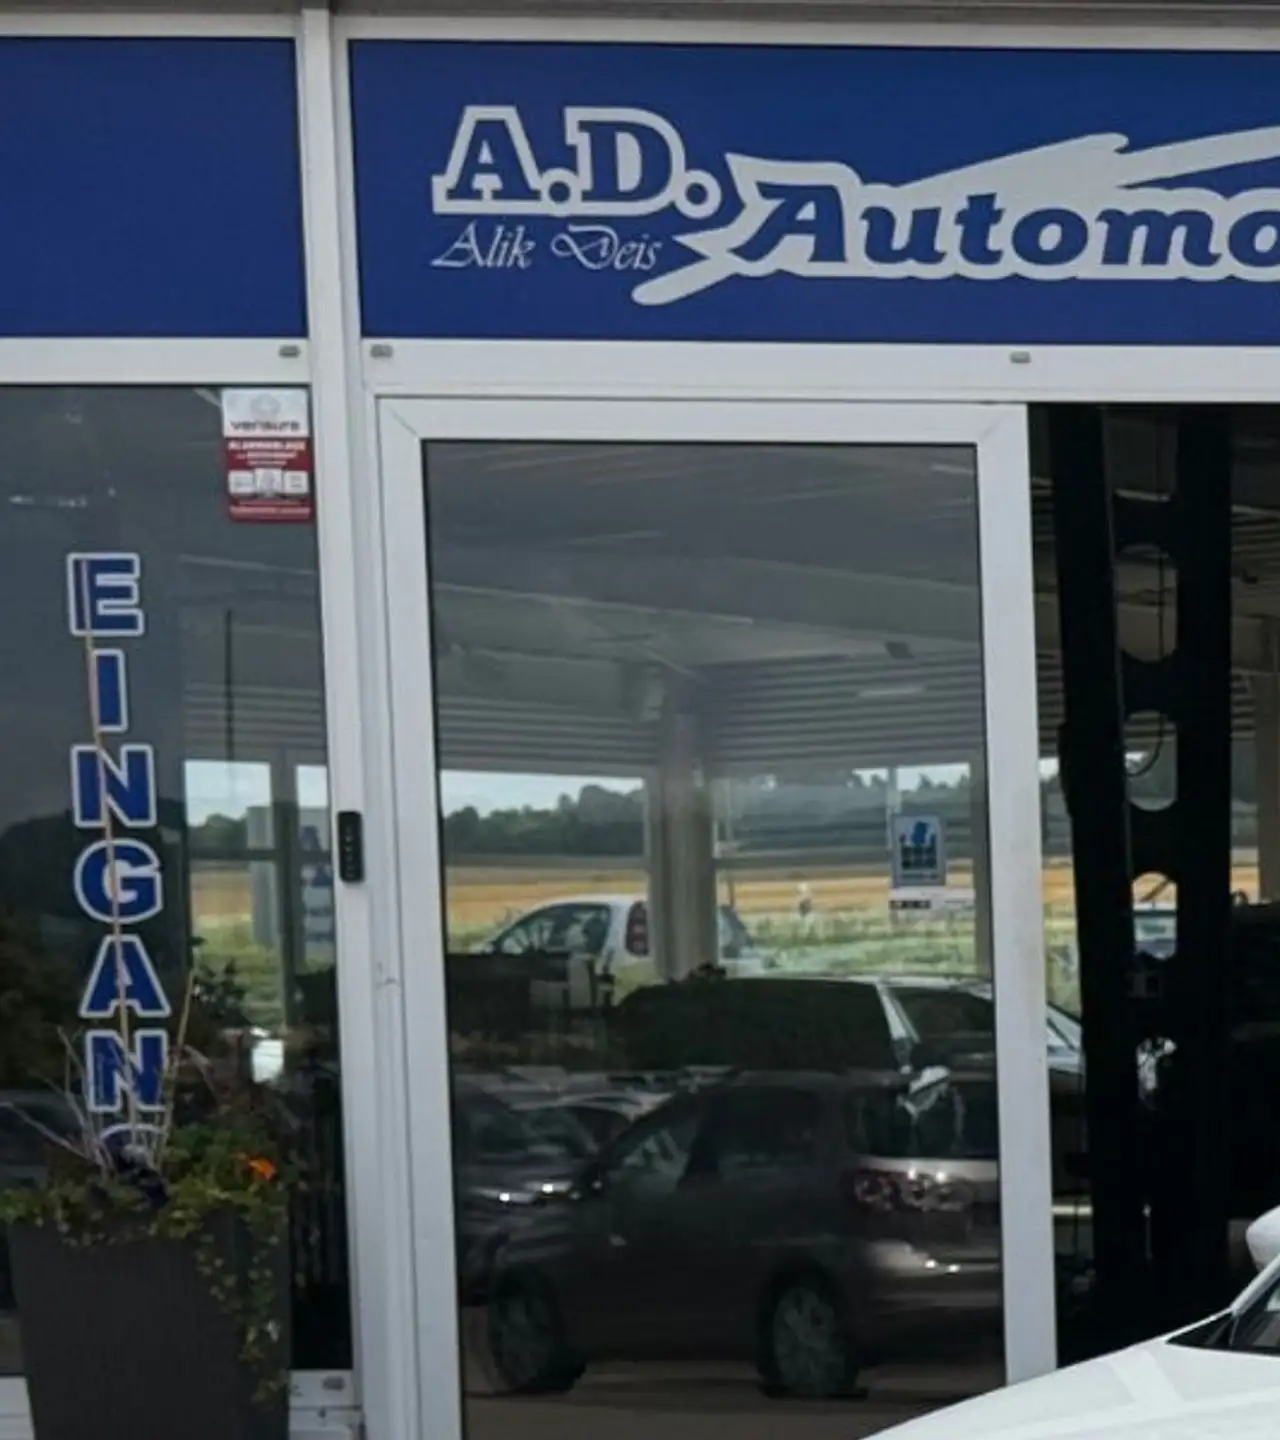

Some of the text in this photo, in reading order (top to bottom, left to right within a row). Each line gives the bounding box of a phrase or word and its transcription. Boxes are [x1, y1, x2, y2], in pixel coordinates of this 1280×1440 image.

[431, 105, 722, 215] A.D.
[430, 222, 664, 274] Alik Deis
